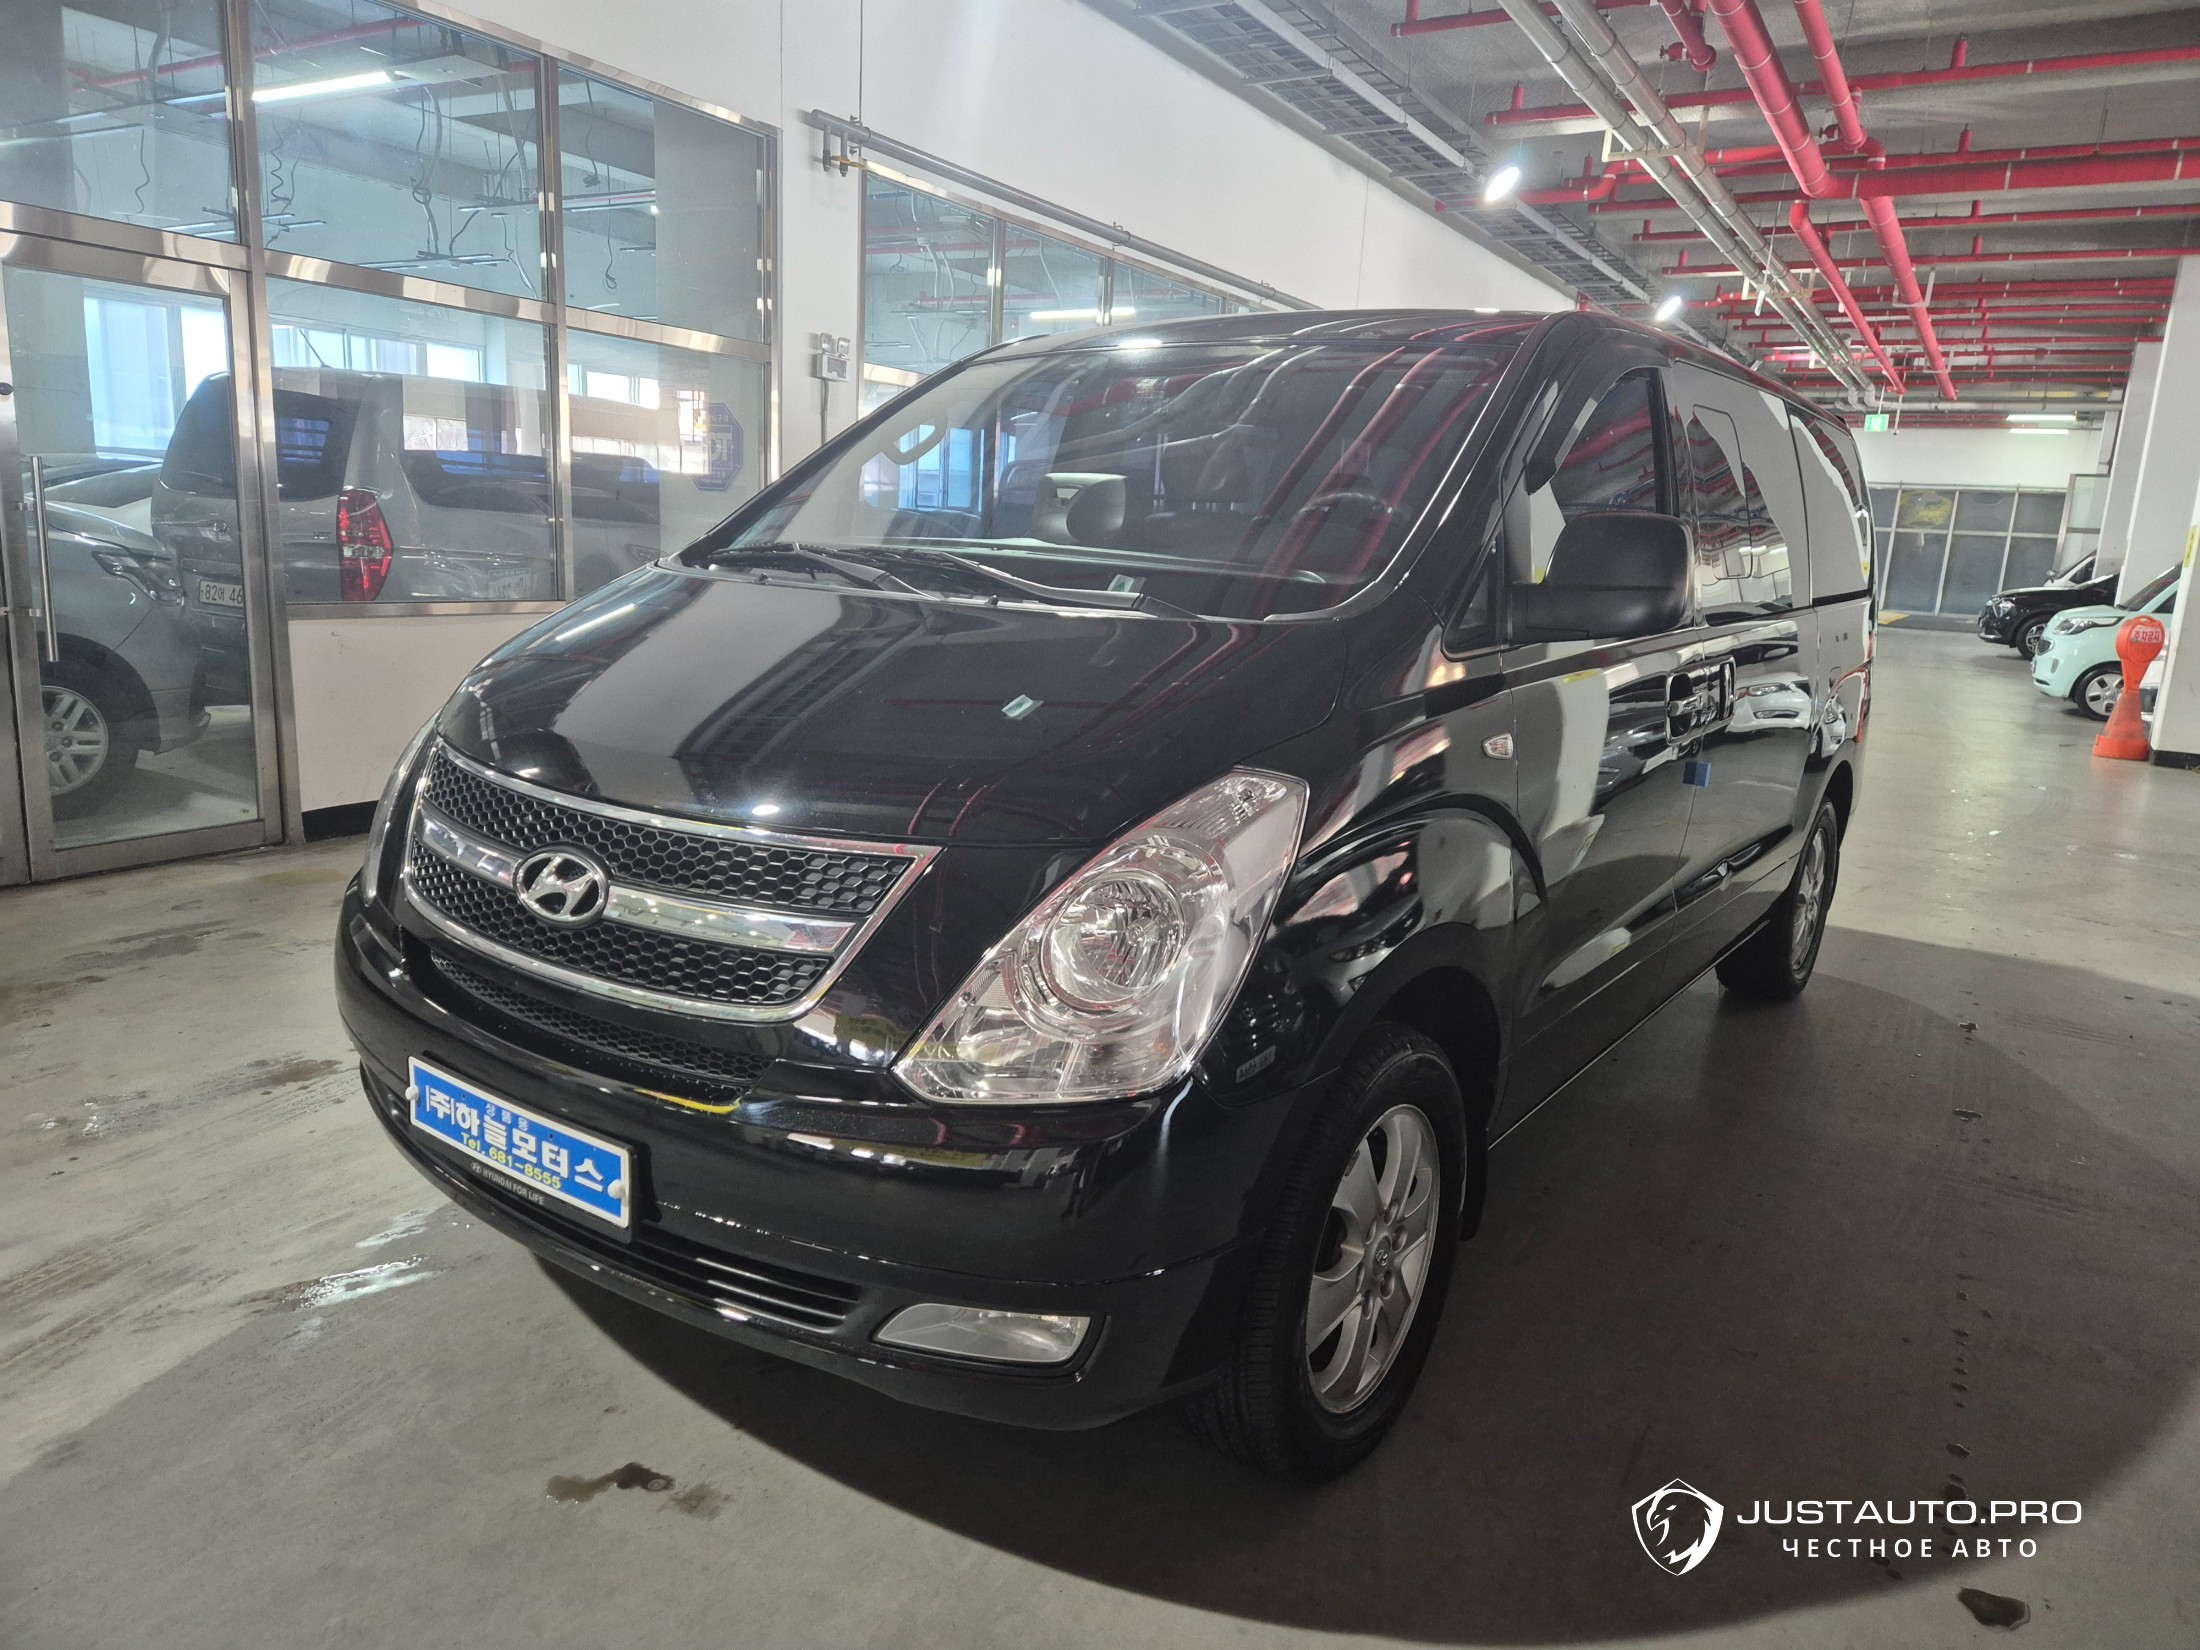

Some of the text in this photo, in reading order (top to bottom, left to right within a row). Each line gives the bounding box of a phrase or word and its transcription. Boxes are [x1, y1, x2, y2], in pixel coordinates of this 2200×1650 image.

[482, 1166, 544, 1206] HYUNDAI FOR LIFE
[489, 1146, 561, 1190] 681-8555
